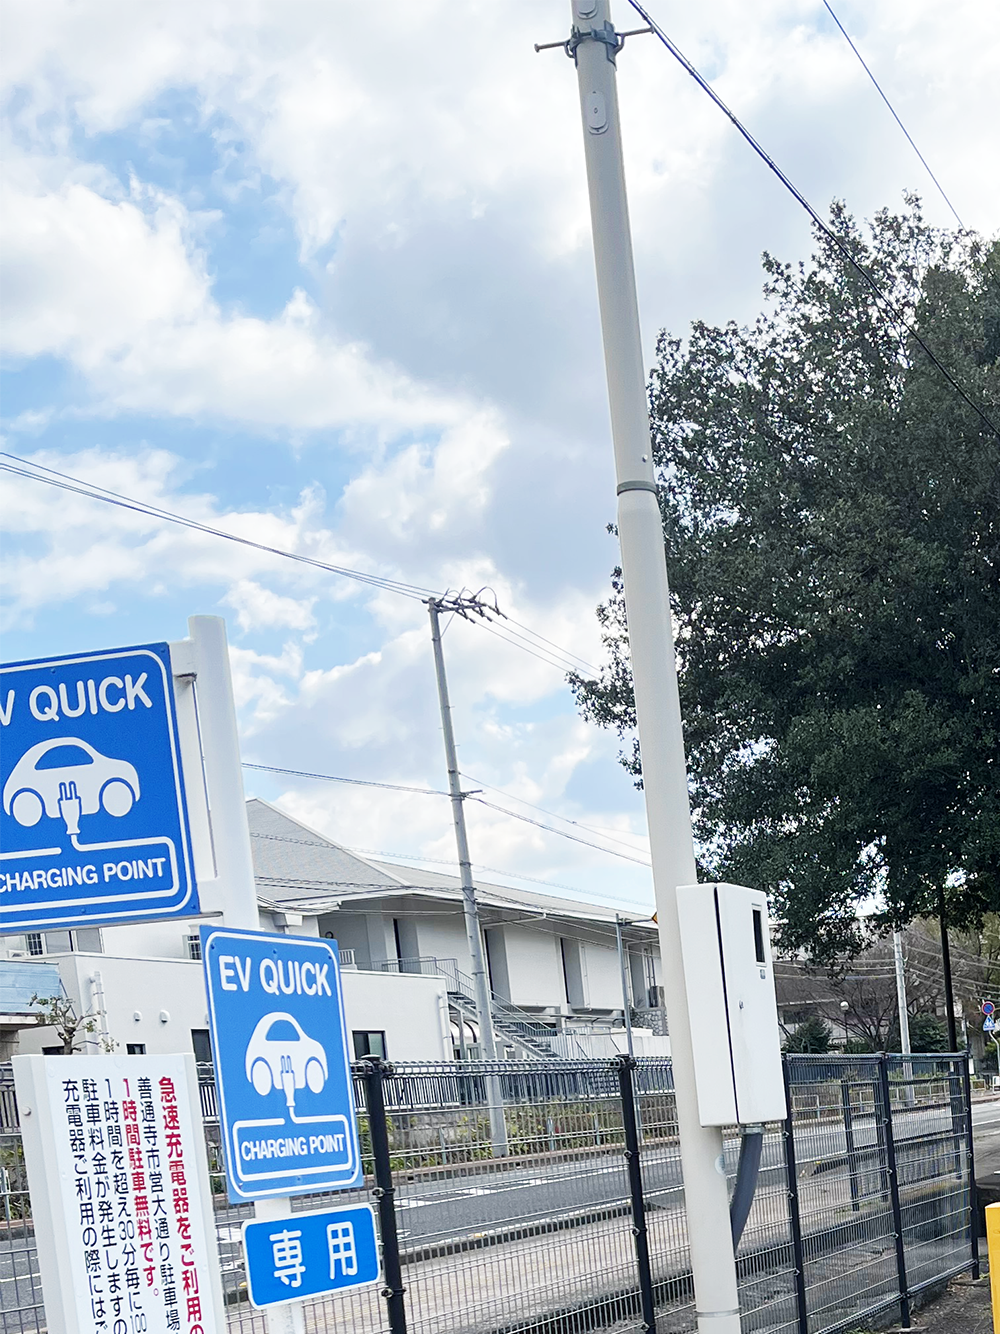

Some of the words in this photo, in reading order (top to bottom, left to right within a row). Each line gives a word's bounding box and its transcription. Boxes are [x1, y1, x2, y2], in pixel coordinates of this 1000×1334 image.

[29, 672, 152, 721] QUICK
[103, 857, 166, 883] POINT
[218, 955, 251, 992] EV
[259, 958, 332, 997] QUICK
[240, 1136, 309, 1161] CHARGING
[309, 1133, 345, 1155] POINT
